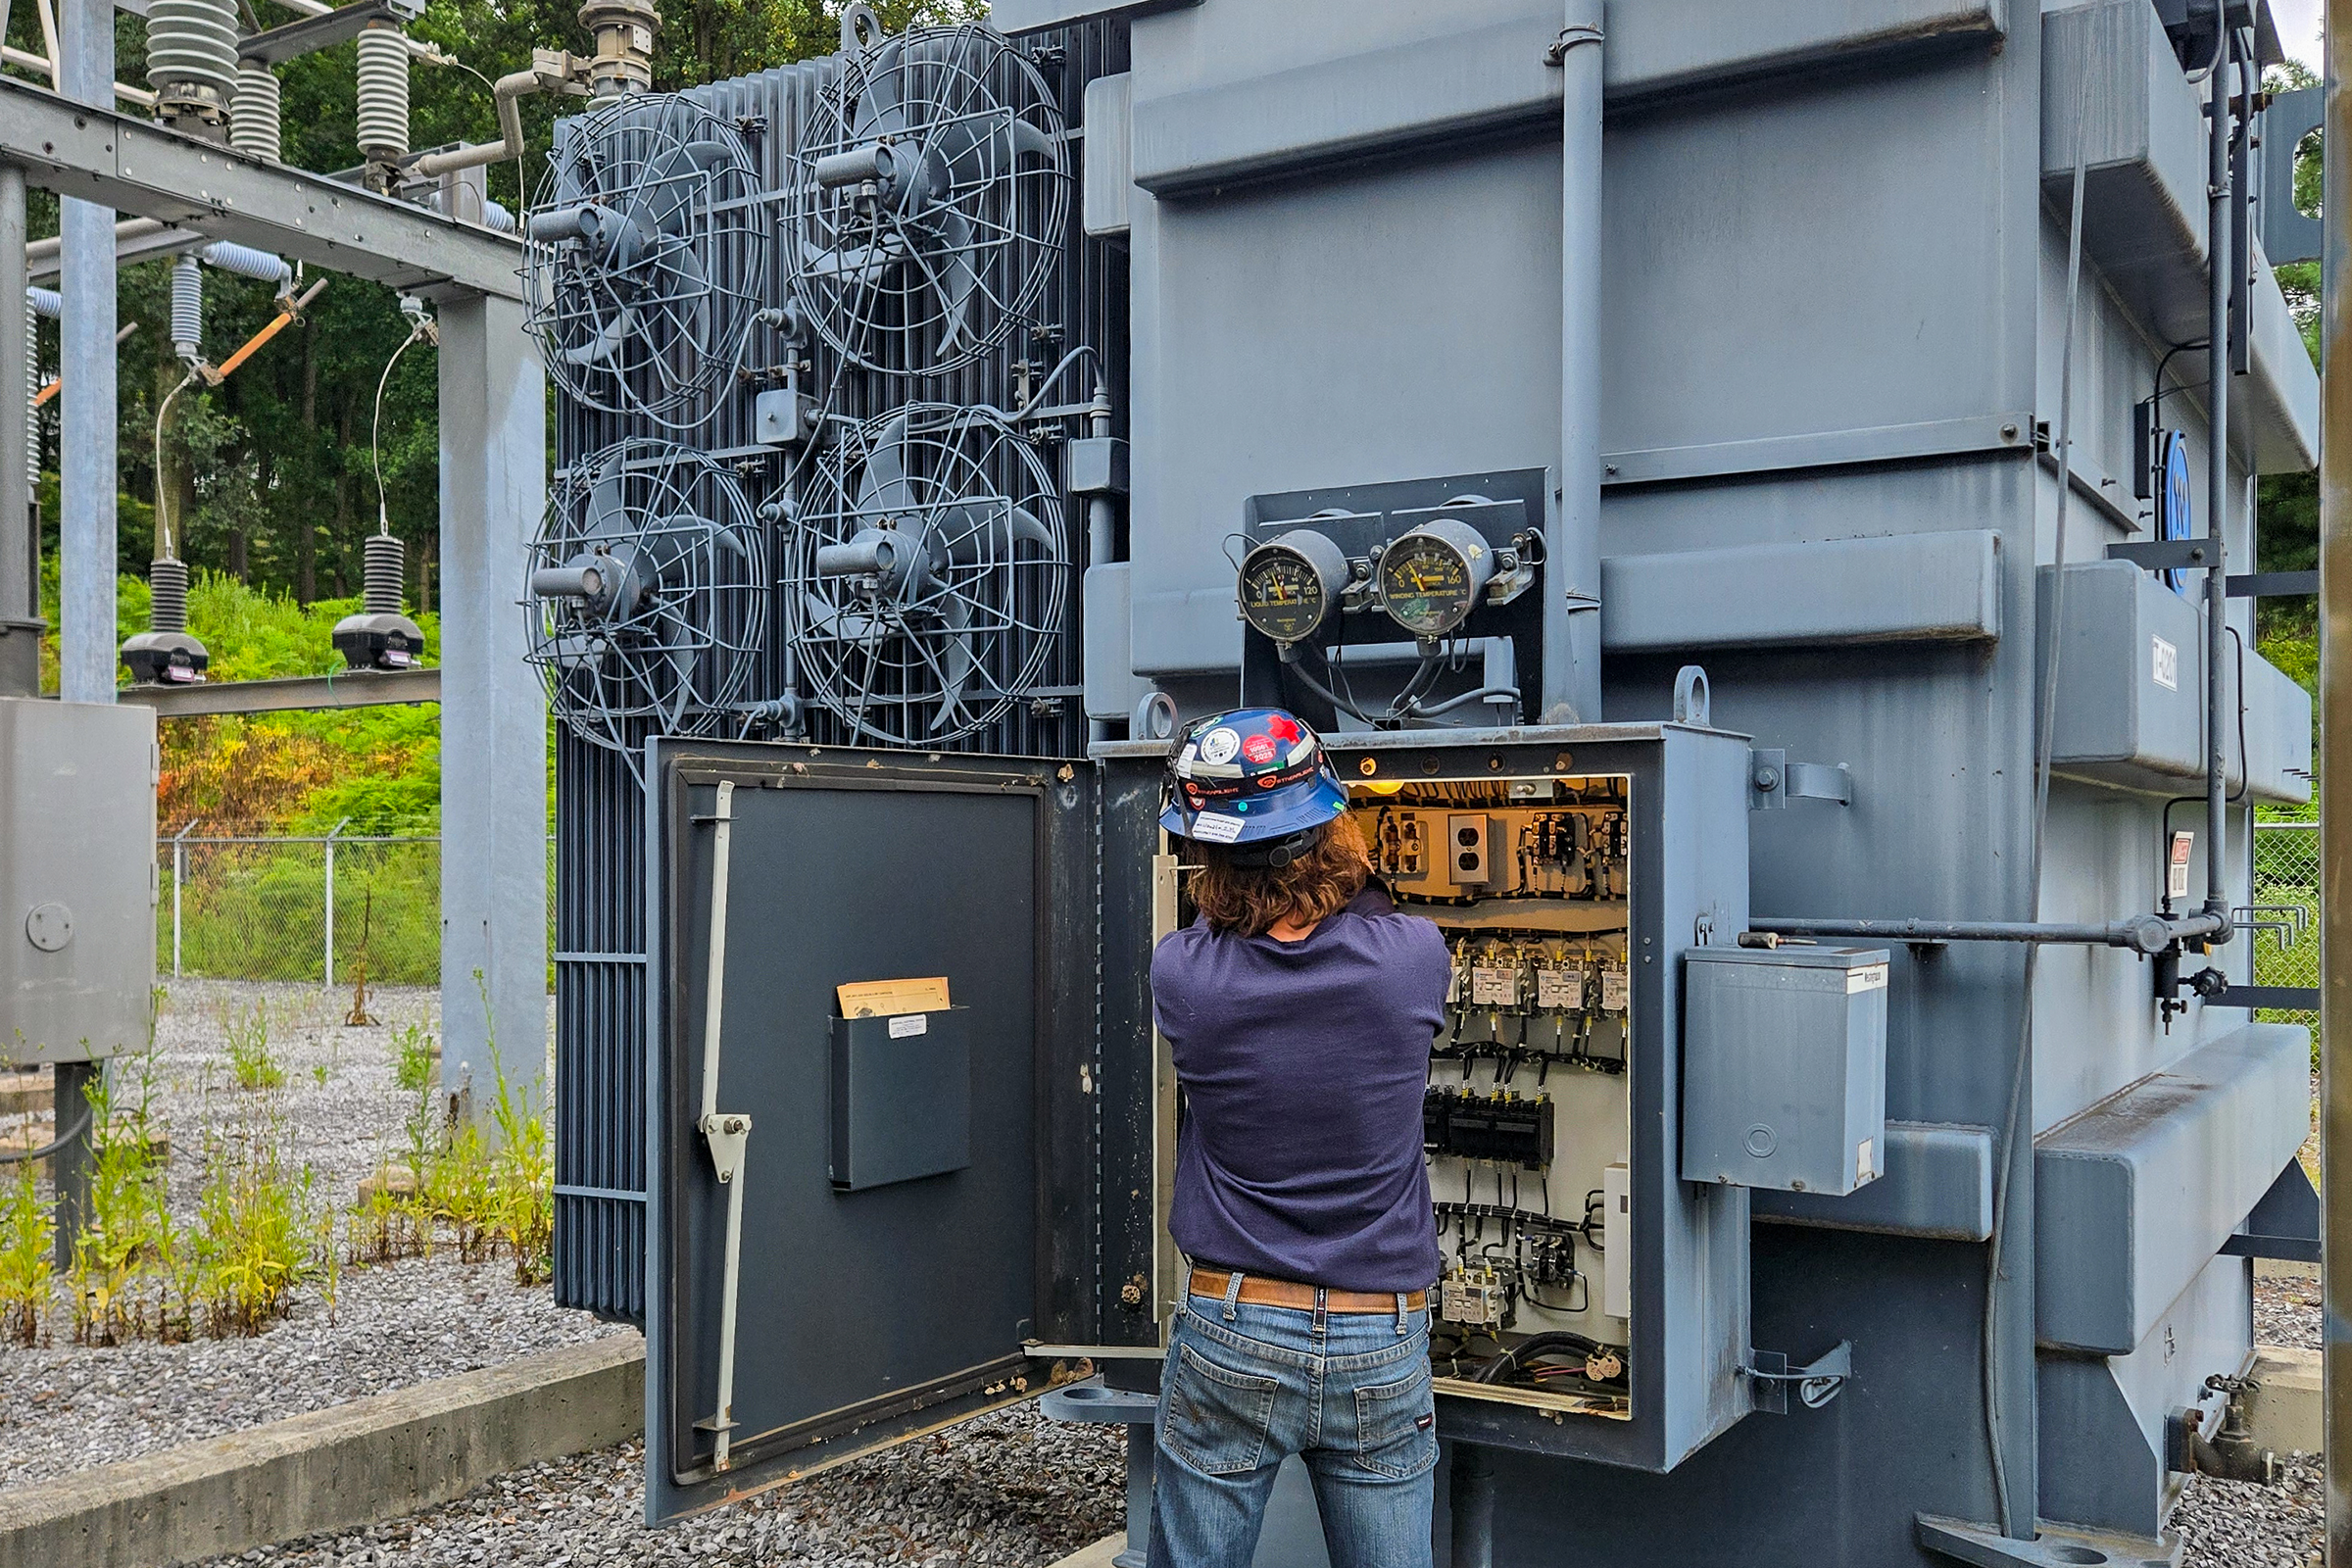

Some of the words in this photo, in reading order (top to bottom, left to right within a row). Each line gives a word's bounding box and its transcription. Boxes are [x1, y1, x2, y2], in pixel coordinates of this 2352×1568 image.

[1398, 579, 1405, 588] 0
[1446, 575, 1462, 585] 160
[1255, 590, 1263, 599] 0
[1303, 586, 1318, 595] 120
[1415, 589, 1458, 598] TEMPERATURE
[1253, 751, 1274, 762] 2025
